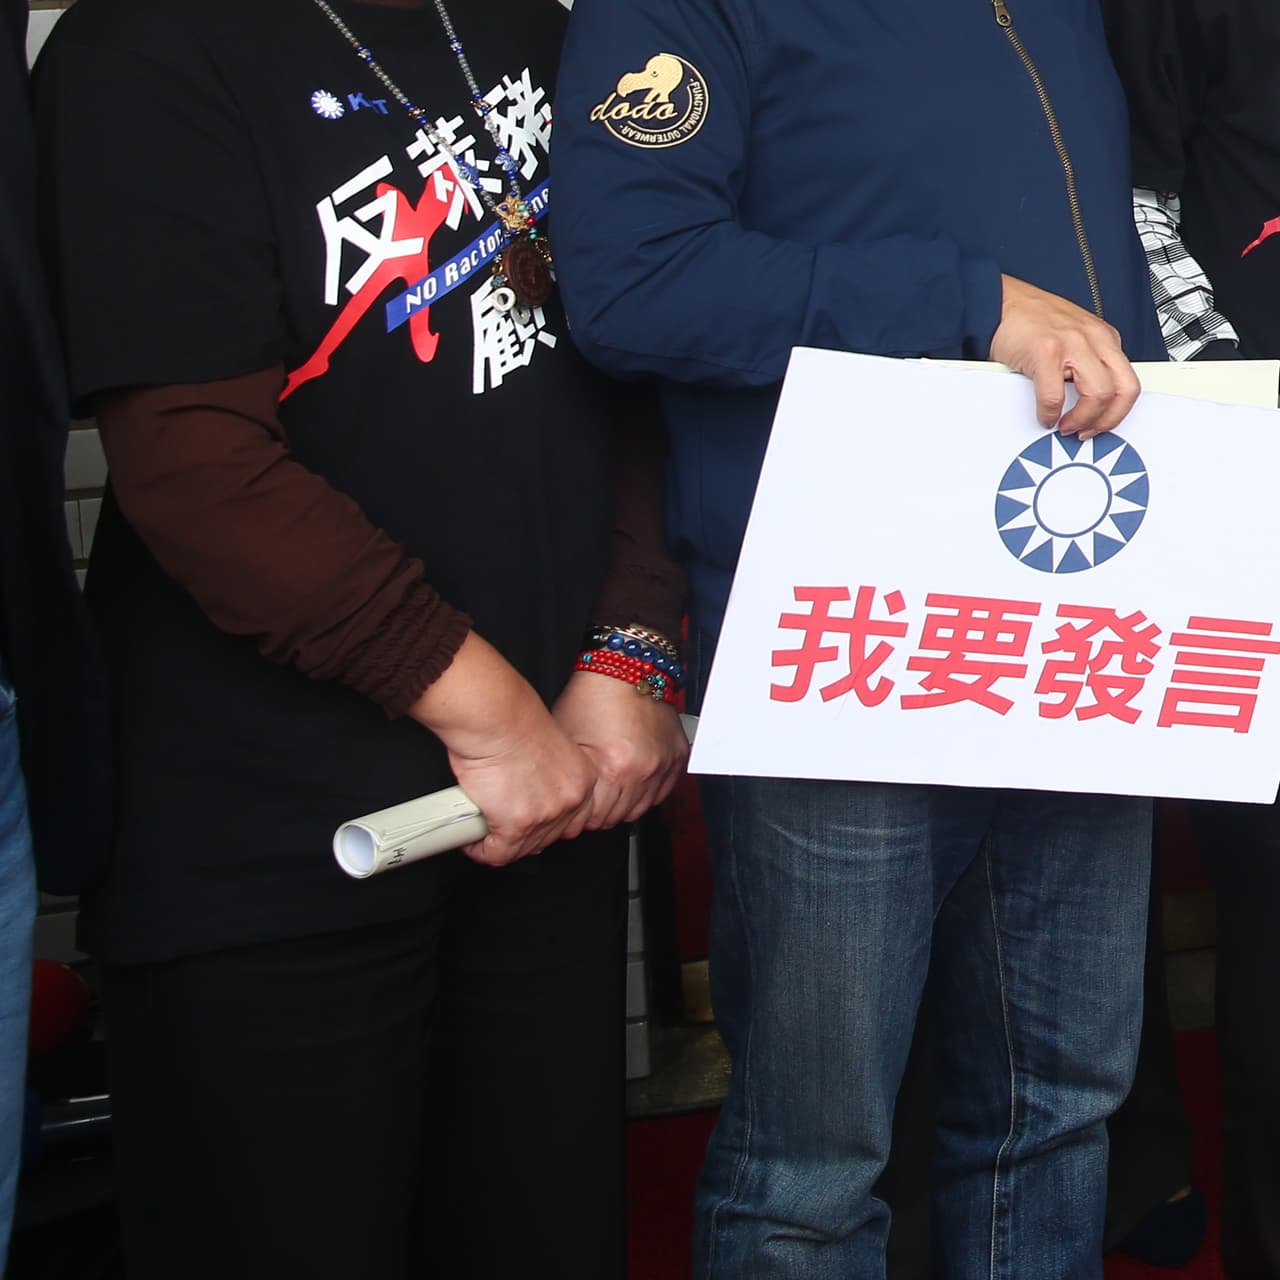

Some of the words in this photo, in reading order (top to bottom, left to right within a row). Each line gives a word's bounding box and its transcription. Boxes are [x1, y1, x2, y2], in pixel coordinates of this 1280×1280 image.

[590, 92, 678, 122] dodo
[679, 81, 704, 135] FUNCTIONAL
[621, 125, 682, 143] OUTERWEAR
[405, 276, 437, 314] NO
